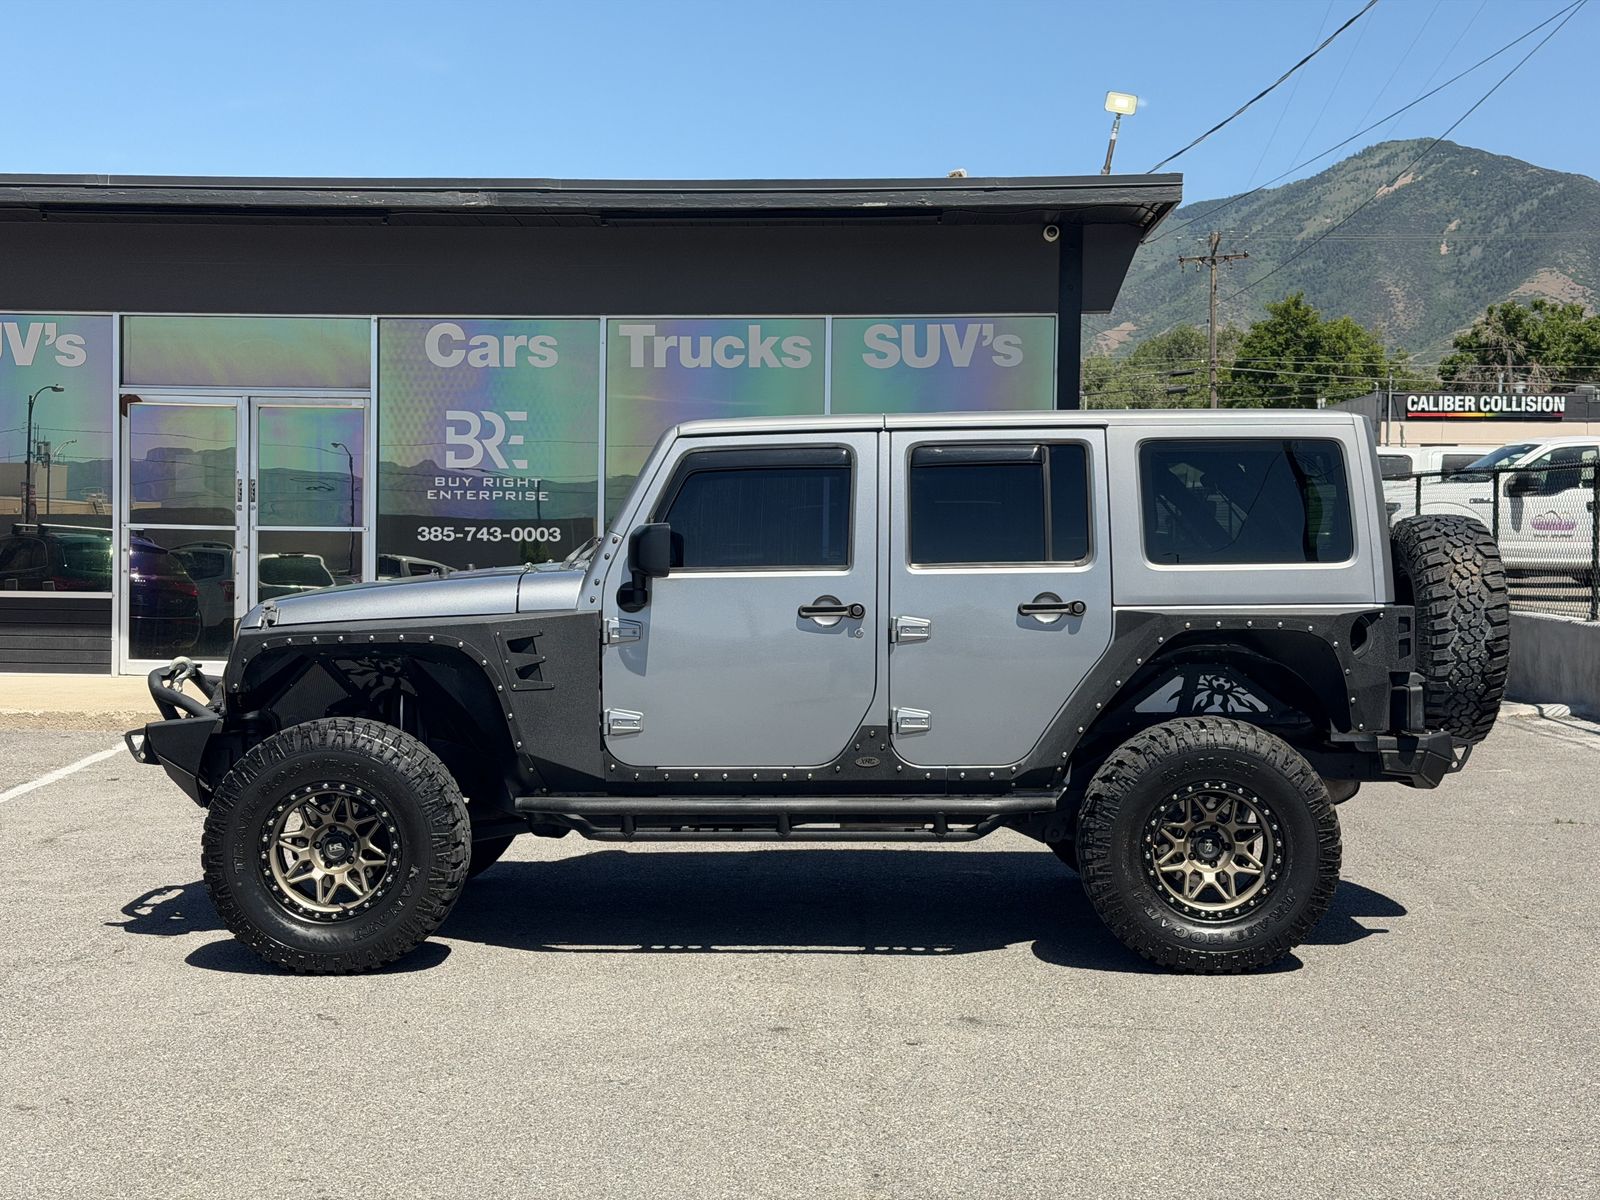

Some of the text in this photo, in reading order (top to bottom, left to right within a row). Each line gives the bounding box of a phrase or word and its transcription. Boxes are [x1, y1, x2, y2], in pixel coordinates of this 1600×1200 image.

[0, 322, 87, 368] V's
[425, 322, 559, 368] Cars
[618, 324, 813, 369] Trucks
[862, 323, 1024, 369] SUV's
[1407, 395, 1566, 412] CALIBER COLLISION
[445, 410, 528, 469] BRE
[427, 489, 550, 501] ENTERPRISE
[434, 476, 542, 488] BUY RIGHT
[416, 526, 562, 542] 385-743-0003
